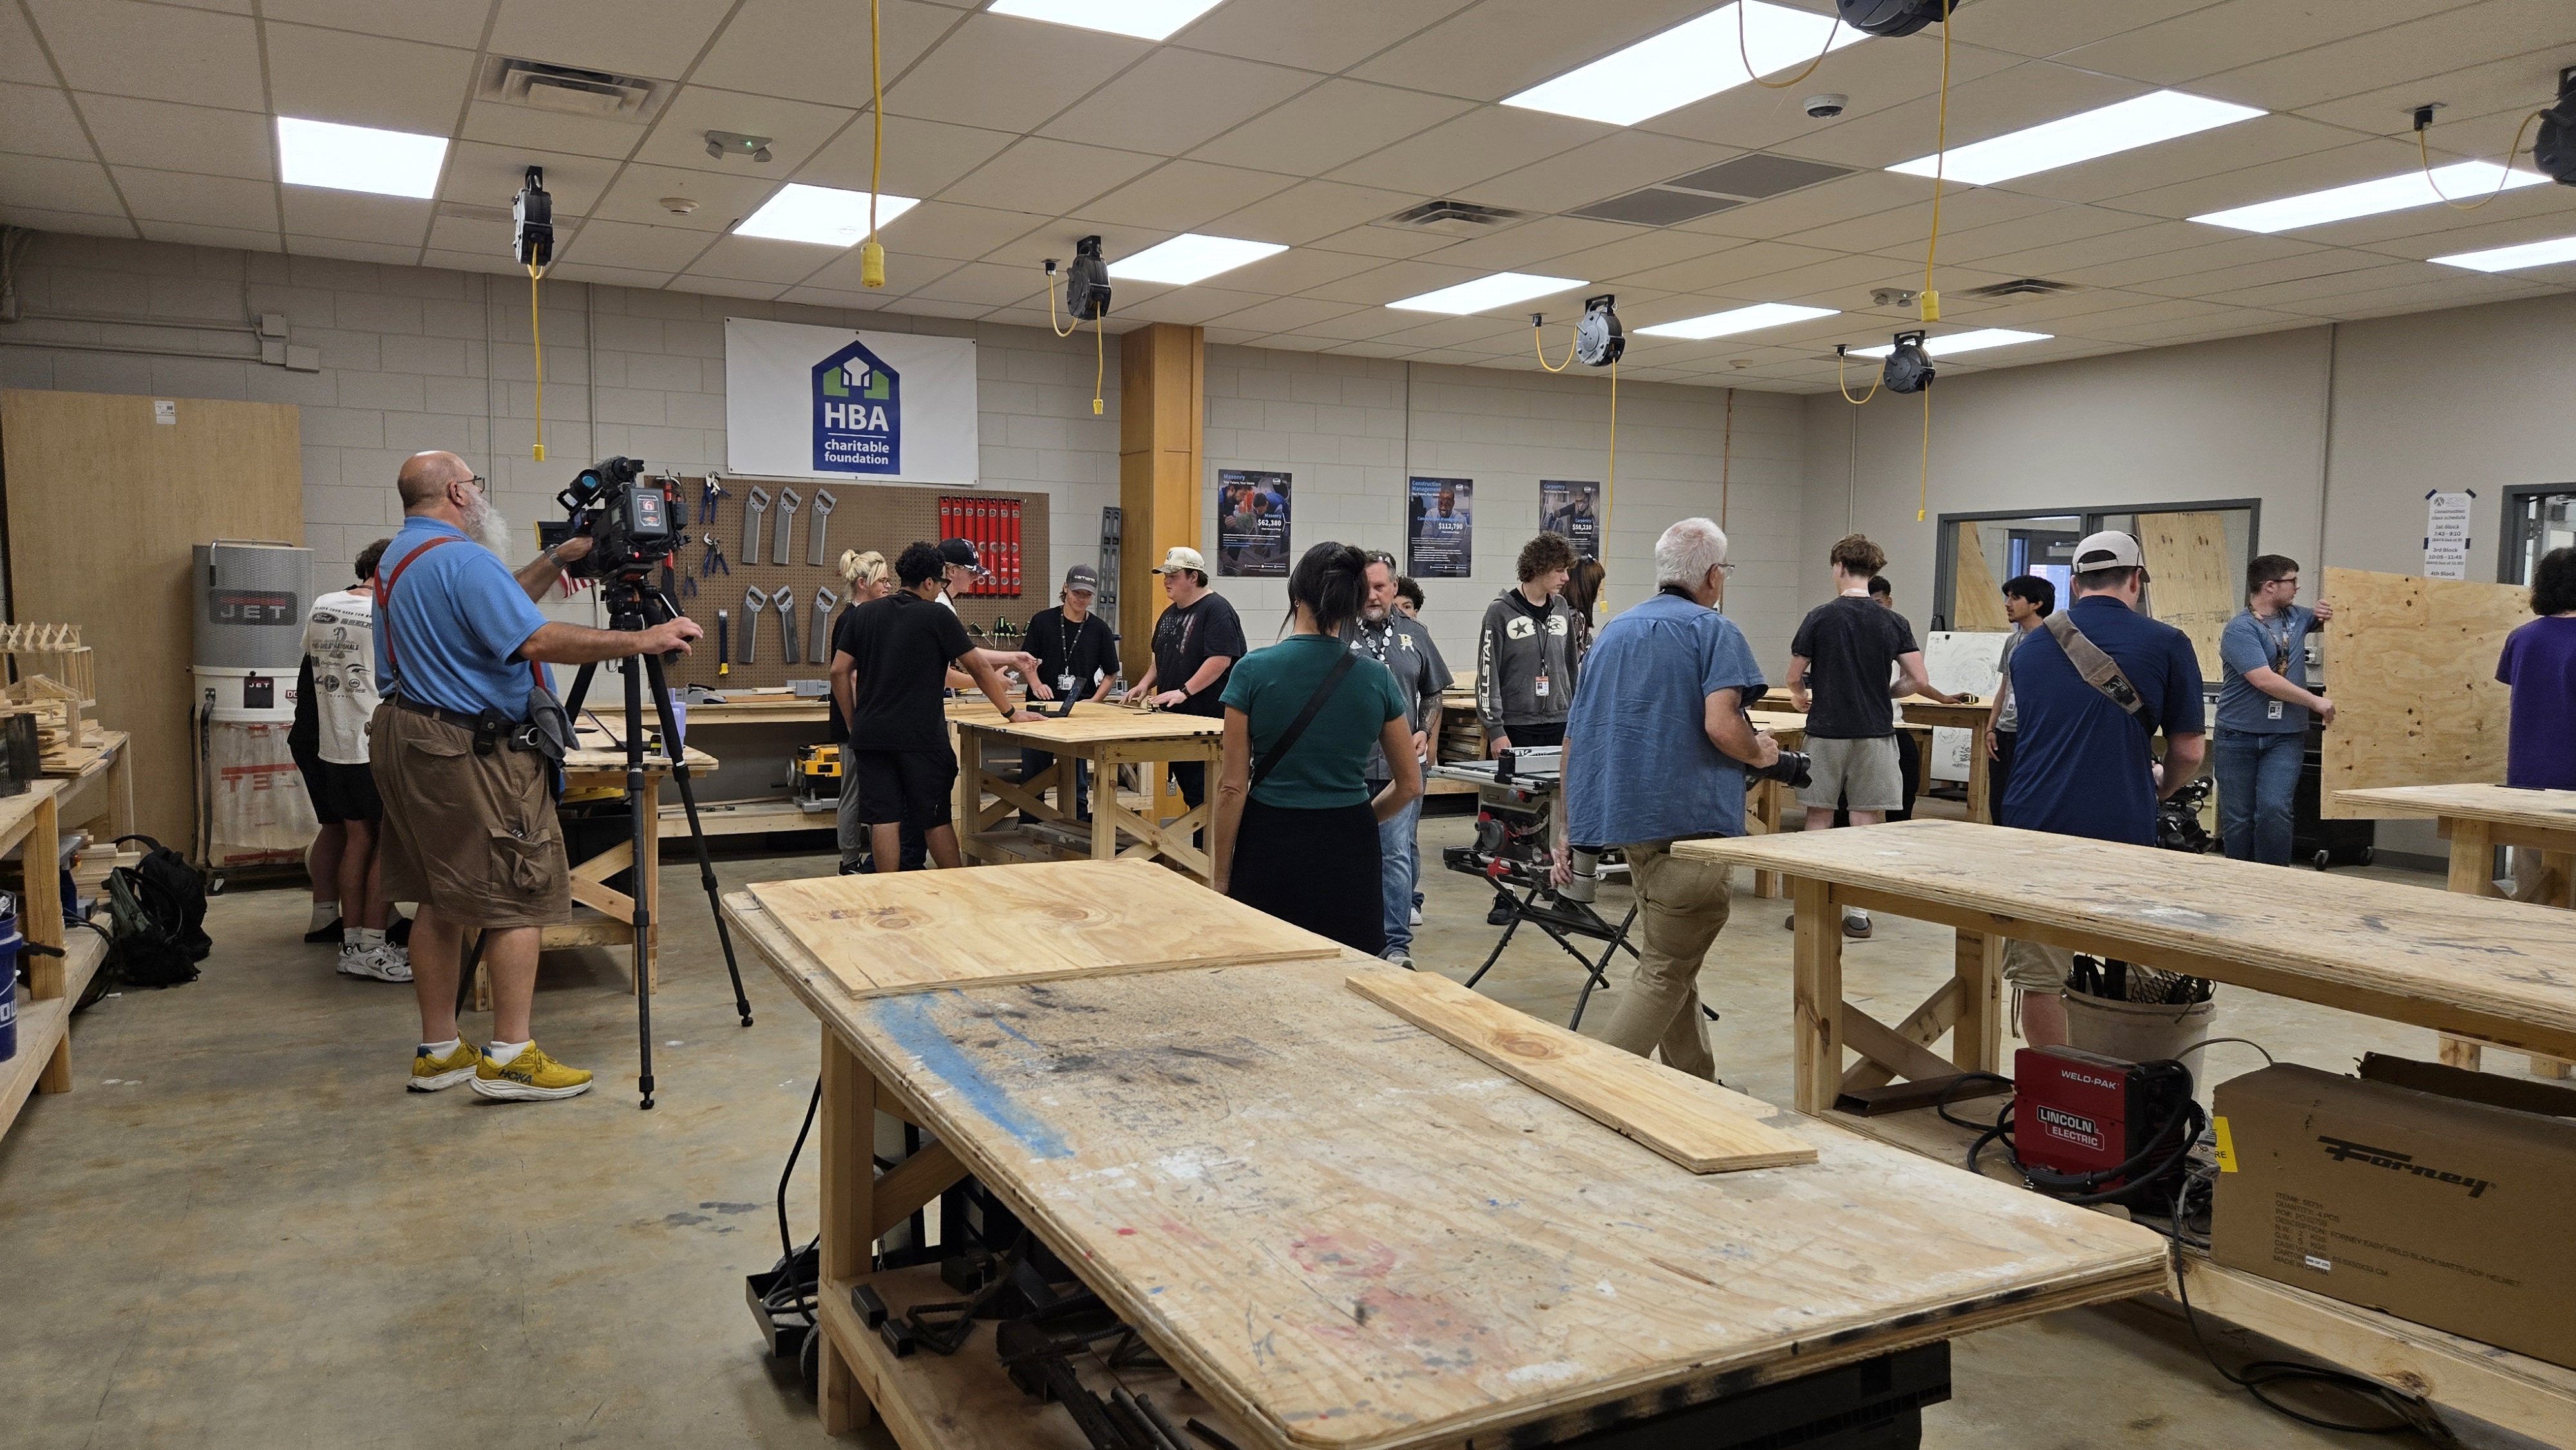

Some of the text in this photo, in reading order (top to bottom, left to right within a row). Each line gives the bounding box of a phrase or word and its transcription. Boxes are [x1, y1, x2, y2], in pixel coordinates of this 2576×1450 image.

[824, 402, 889, 431] HBA
[824, 439, 889, 453] charitable
[824, 451, 889, 464] foundation
[1258, 518, 1282, 527] $62,380
[1438, 522, 1463, 531] $112,790
[221, 605, 286, 619] JET
[314, 614, 332, 622] Ford
[1481, 629, 1493, 720] HELLSTAR
[498, 1068, 533, 1085] HOKA
[2061, 1069, 2117, 1090] WELD-PAK
[2040, 1109, 2092, 1133] LINCOLN
[2052, 1127, 2098, 1146] ELECTRIC
[2317, 1135, 2489, 1198] Forney
[2324, 1213, 2340, 1222] PCS
[2310, 1234, 2327, 1243] KGS
[2310, 1241, 2327, 1251] KGS
[2273, 1256, 2295, 1266] MADE
[2306, 1265, 2329, 1277] CHINA
[2275, 1239, 2295, 1250] CASE
[2376, 1268, 2388, 1277] CM
[2330, 1231, 2362, 1245] FORNEY
[2363, 1239, 2384, 1250] EASY
[2384, 1243, 2409, 1257] WELD
[2410, 1252, 2436, 1265] BLACK
[2438, 1260, 2467, 1273] MATTE
[2467, 1268, 2484, 1277] ADF
[2486, 1273, 2521, 1287] HELMET
